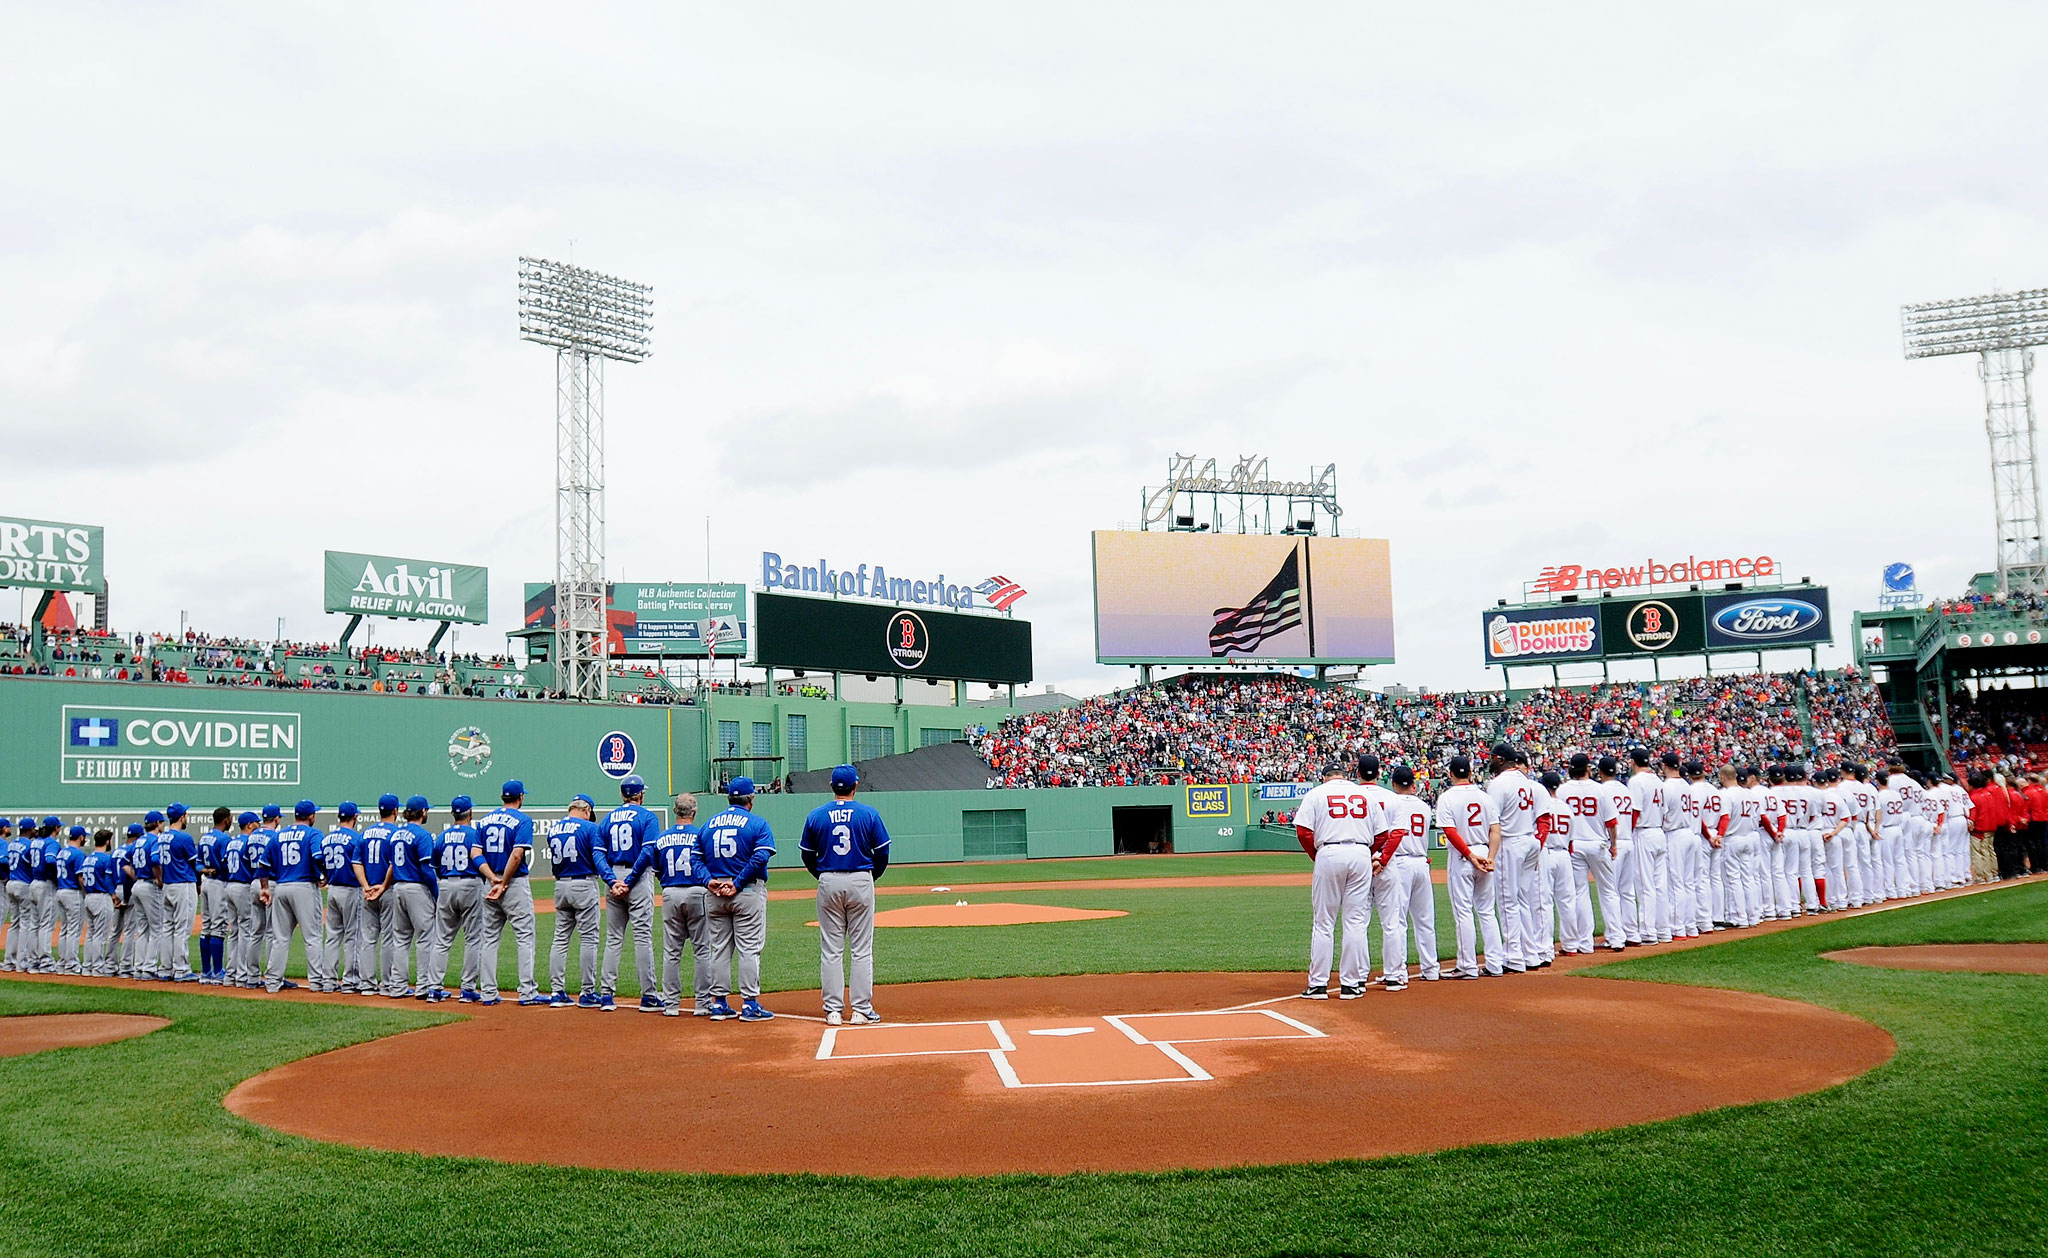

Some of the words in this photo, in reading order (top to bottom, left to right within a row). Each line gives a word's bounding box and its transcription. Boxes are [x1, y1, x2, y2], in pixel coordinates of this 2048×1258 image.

[352, 560, 453, 600] Advil
[762, 551, 836, 594] Bank
[839, 563, 867, 597] of
[870, 565, 974, 609] America
[638, 588, 655, 599] MLB
[656, 587, 694, 599] Authentic
[350, 595, 394, 611] RELIEF
[395, 599, 413, 613] IN
[415, 602, 466, 617] ACTION
[637, 600, 666, 612] Batting
[668, 600, 703, 610] Practice
[1643, 607, 1661, 633] B
[1733, 604, 1800, 632] Ford
[900, 618, 916, 648] B
[1519, 620, 1591, 638] DUNKIN'
[1635, 631, 1672, 641] STRONG
[1520, 634, 1590, 651] DONUTS
[893, 648, 923, 659] STRONG
[126, 719, 294, 749] COVIDIEN
[610, 737, 625, 762] B
[76, 760, 144, 778] FENWAY
[150, 761, 191, 779] PARK
[222, 762, 253, 780] EST.
[257, 763, 287, 780] 1912
[1192, 790, 1222, 801] GIANT
[1265, 785, 1292, 798] NESN
[1518, 788, 1534, 810] 34
[1653, 788, 1665, 807] 41
[1900, 786, 1913, 801] 30
[1192, 801, 1225, 811] GLASS
[1327, 795, 1367, 819] 53
[1566, 796, 1598, 816] 39
[1613, 796, 1632, 815] 22
[1681, 794, 1692, 813] 31
[1741, 800, 1751, 817] 12
[1765, 795, 1778, 811] 13
[1887, 801, 1903, 815] 32
[75, 816, 118, 825] PARK
[610, 810, 638, 823] KUNTZ
[708, 813, 749, 829] CADAHIA
[828, 809, 854, 824] YOST
[1404, 813, 1425, 836] 8
[1467, 802, 1482, 827] 2
[1550, 814, 1571, 835] 15
[279, 830, 306, 842] BUTLER
[486, 826, 506, 853] 21
[549, 822, 581, 838] MALOOF
[610, 823, 633, 851] 18
[1218, 827, 1233, 836] 420
[550, 836, 578, 865] 34
[656, 833, 698, 851] RODRIGUE
[712, 828, 738, 858] 15
[832, 825, 851, 856] 3
[280, 842, 300, 866] 16
[323, 845, 345, 869] 26
[368, 839, 381, 864] 11
[394, 842, 405, 867] 8
[441, 845, 468, 871] 48
[665, 847, 692, 877] 14
